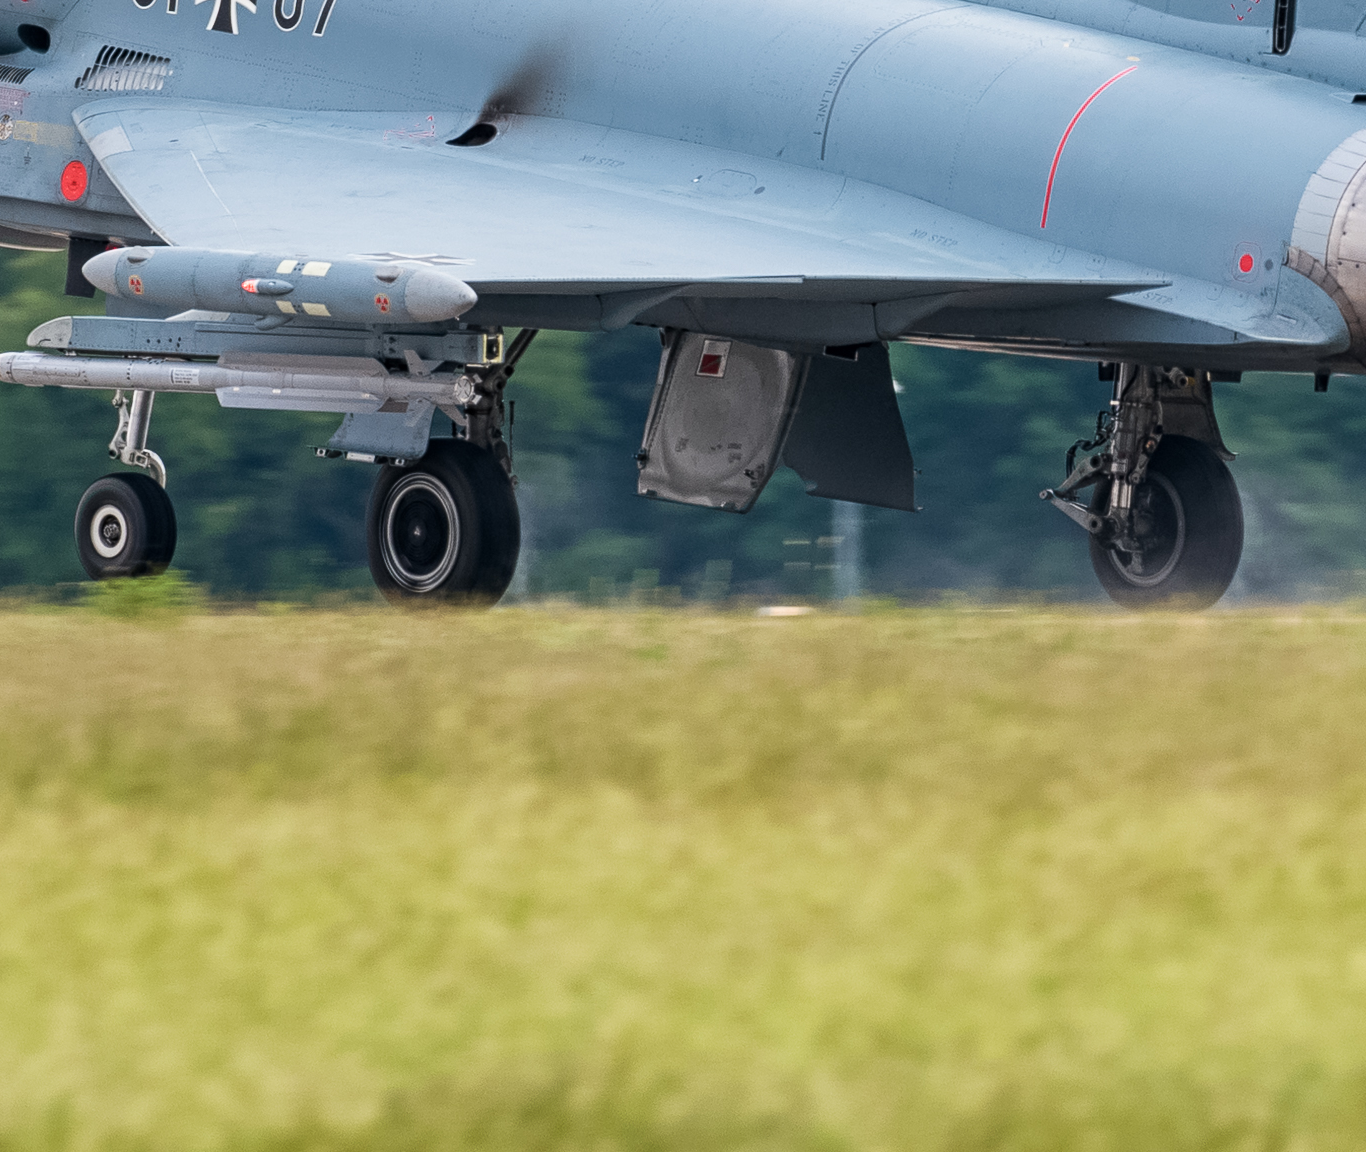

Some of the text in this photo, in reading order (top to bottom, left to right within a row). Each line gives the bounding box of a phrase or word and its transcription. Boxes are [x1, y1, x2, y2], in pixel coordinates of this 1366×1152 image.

[828, 60, 850, 89] THIS
[816, 89, 833, 122] LINE
[596, 158, 625, 168] STEP
[910, 228, 958, 247] NO STEP
